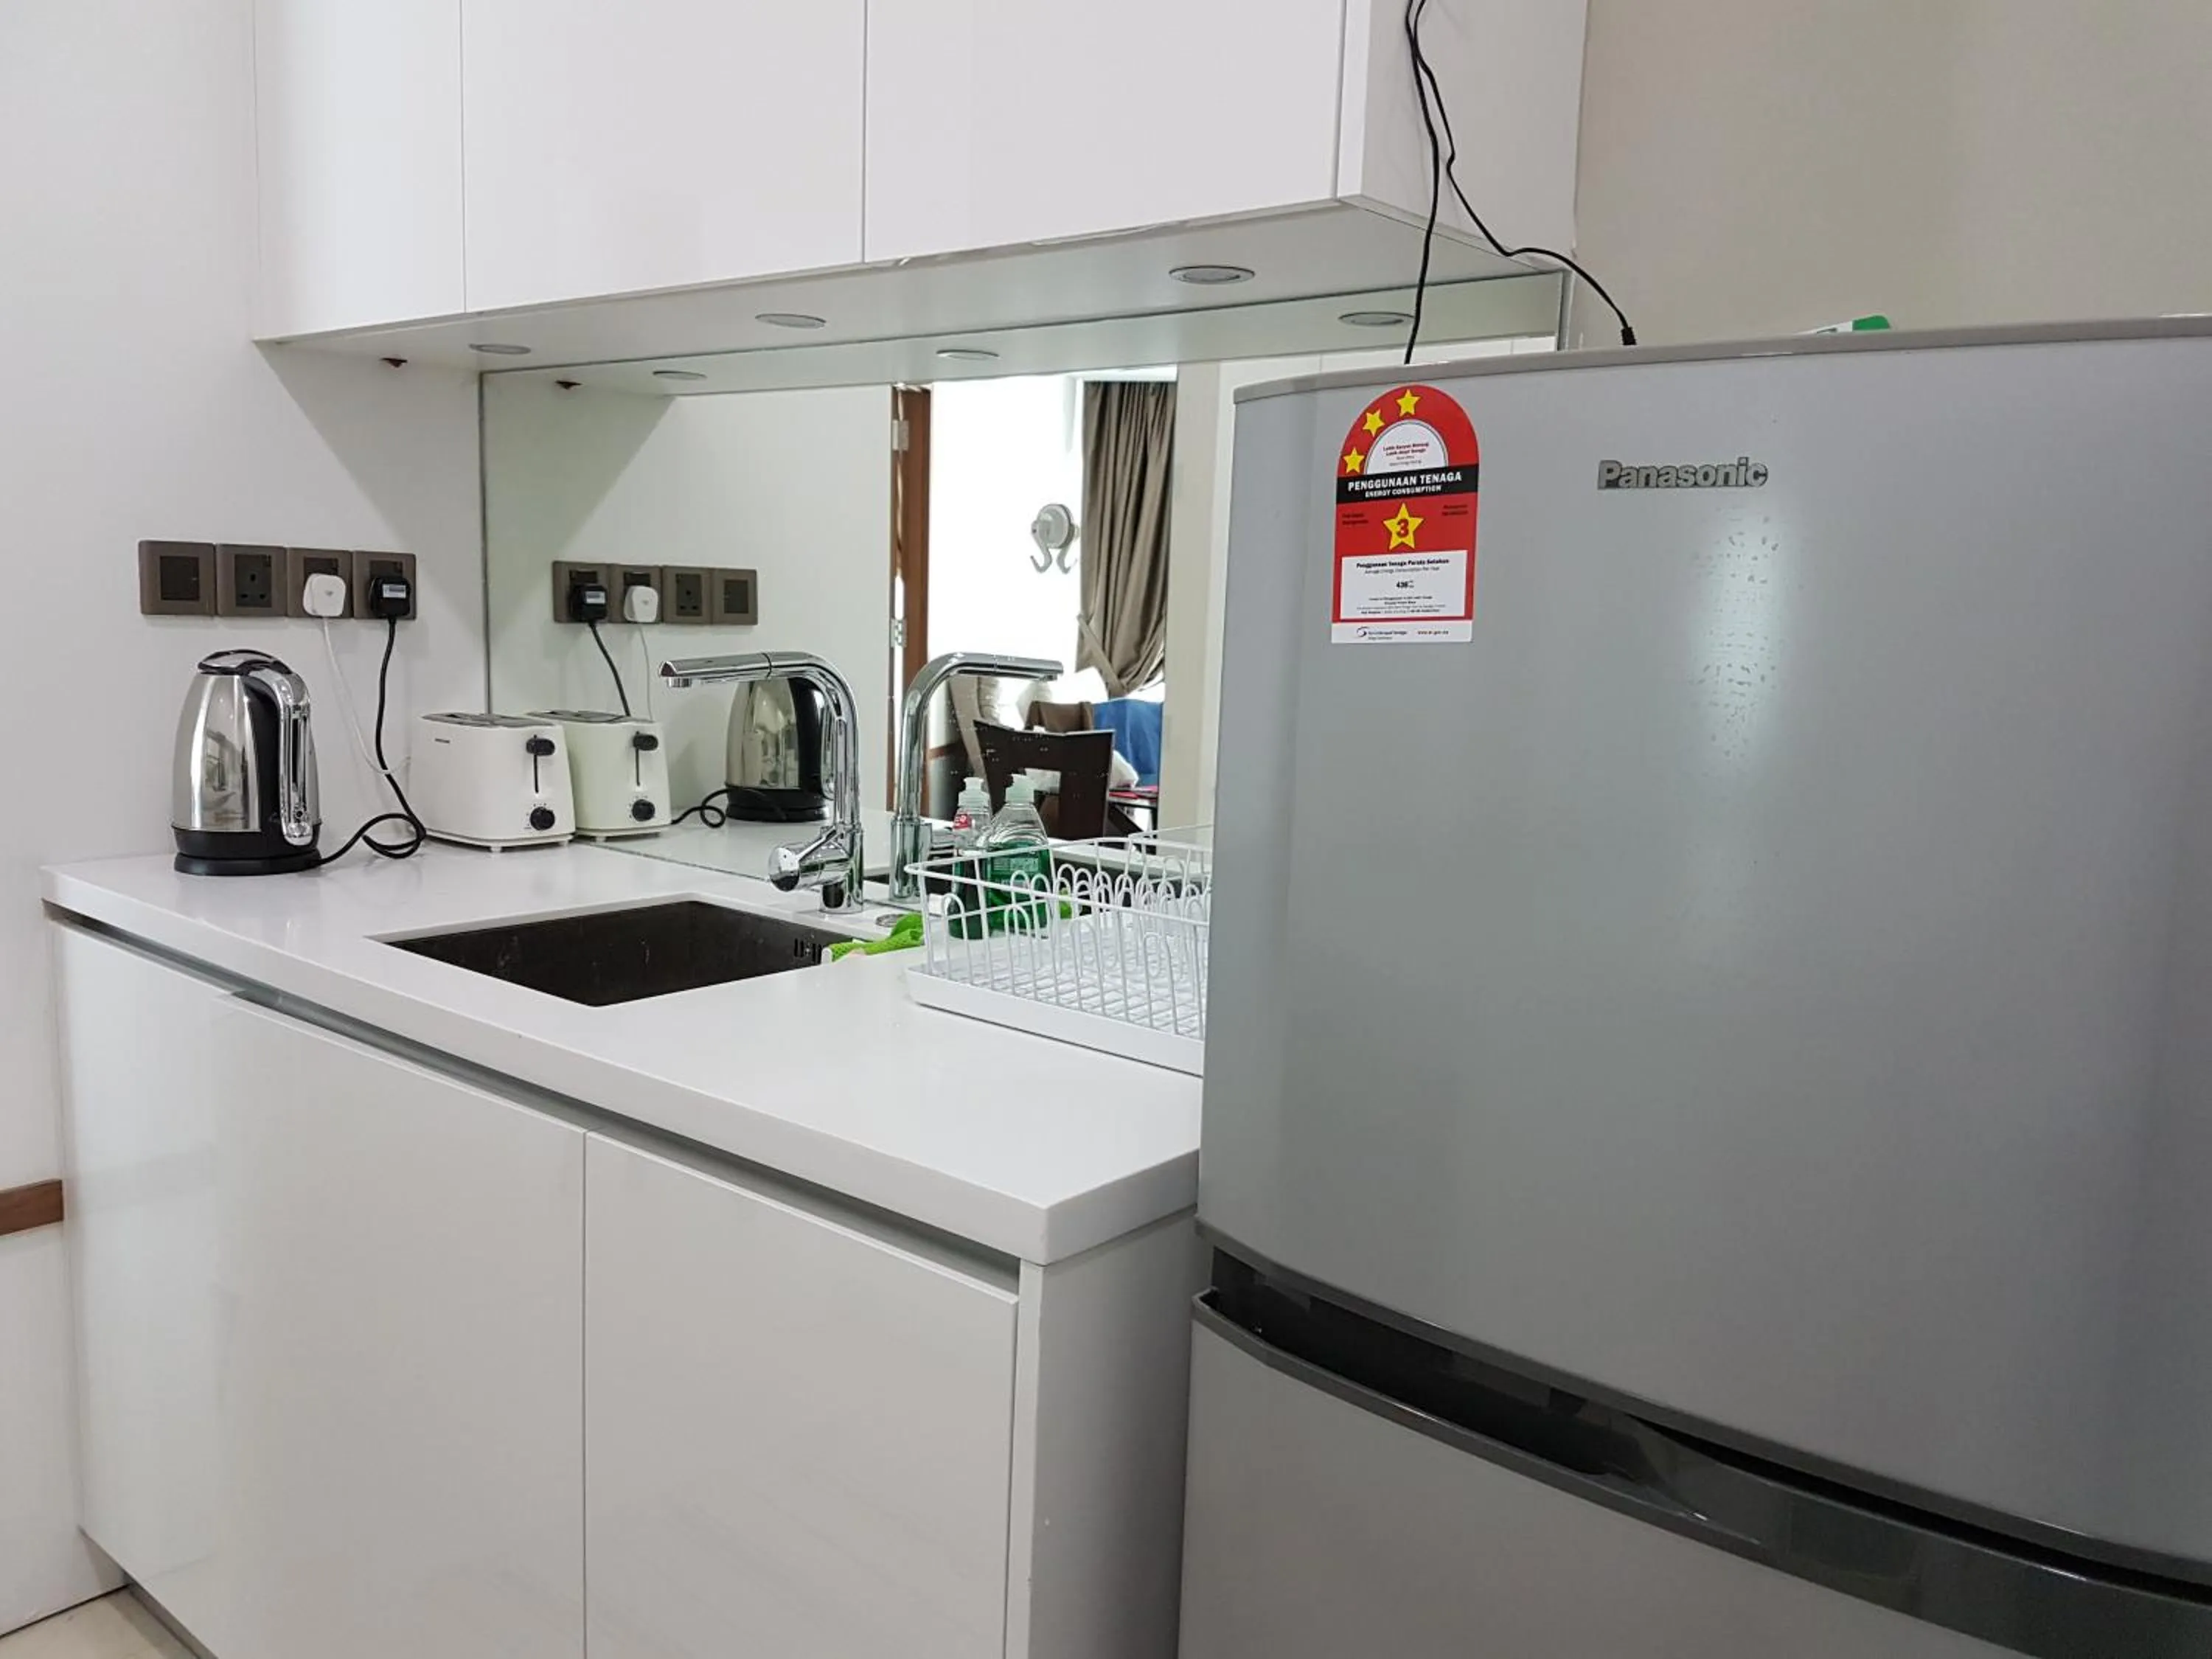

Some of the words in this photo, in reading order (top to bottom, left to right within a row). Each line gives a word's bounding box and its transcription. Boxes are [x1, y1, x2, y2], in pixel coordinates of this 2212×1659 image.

[1348, 476, 1416, 492] PENGGUNAAN
[1420, 472, 1462, 484] TENAGA
[1598, 456, 1768, 490] Panasonic
[1365, 489, 1391, 498] ENERGY
[1392, 484, 1441, 495] CONSUMPTION
[1397, 519, 1409, 538] 3
